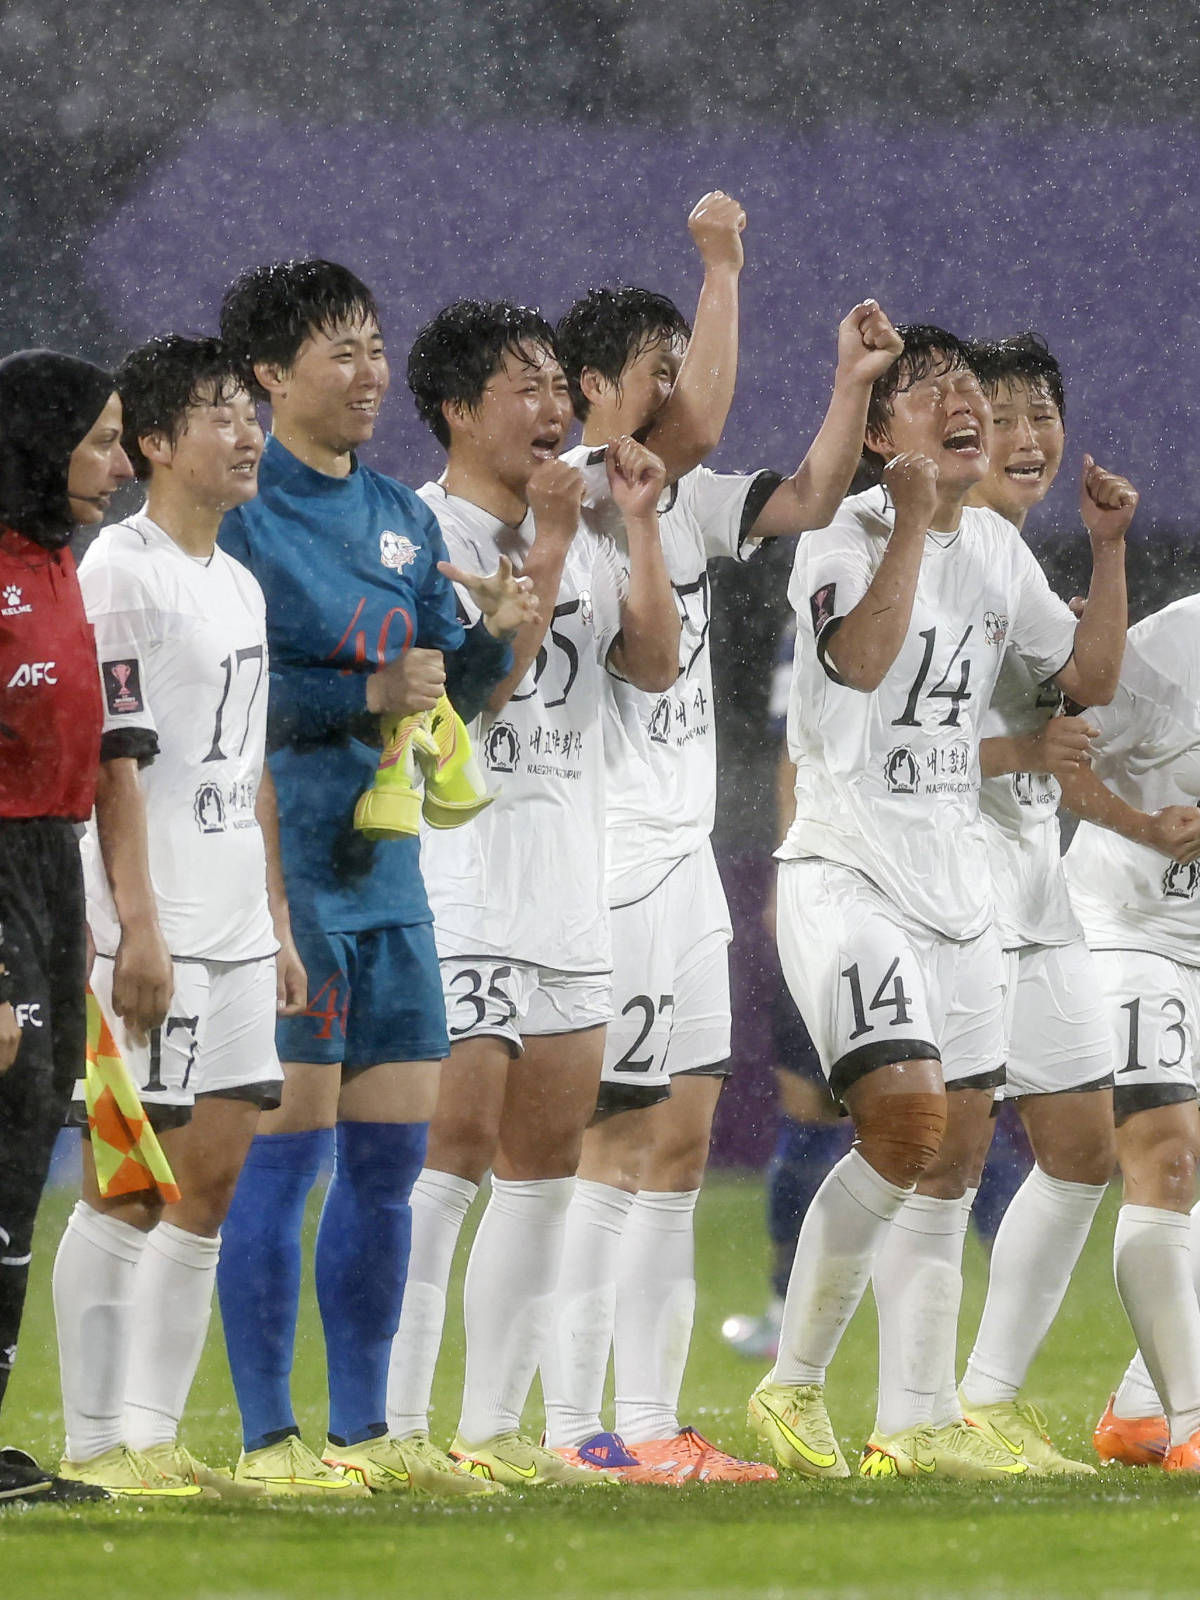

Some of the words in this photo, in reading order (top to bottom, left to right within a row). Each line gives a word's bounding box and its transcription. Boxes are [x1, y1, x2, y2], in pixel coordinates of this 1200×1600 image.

[1, 604, 33, 616] KELME
[7, 661, 58, 688] AFC
[201, 644, 263, 763] 17
[890, 624, 974, 727] 14
[10, 1002, 43, 1028] FC
[449, 965, 517, 1036] 35
[613, 994, 674, 1073] 27
[841, 956, 914, 1041] 14
[1116, 996, 1187, 1075] 13
[141, 1015, 199, 1092] 17
